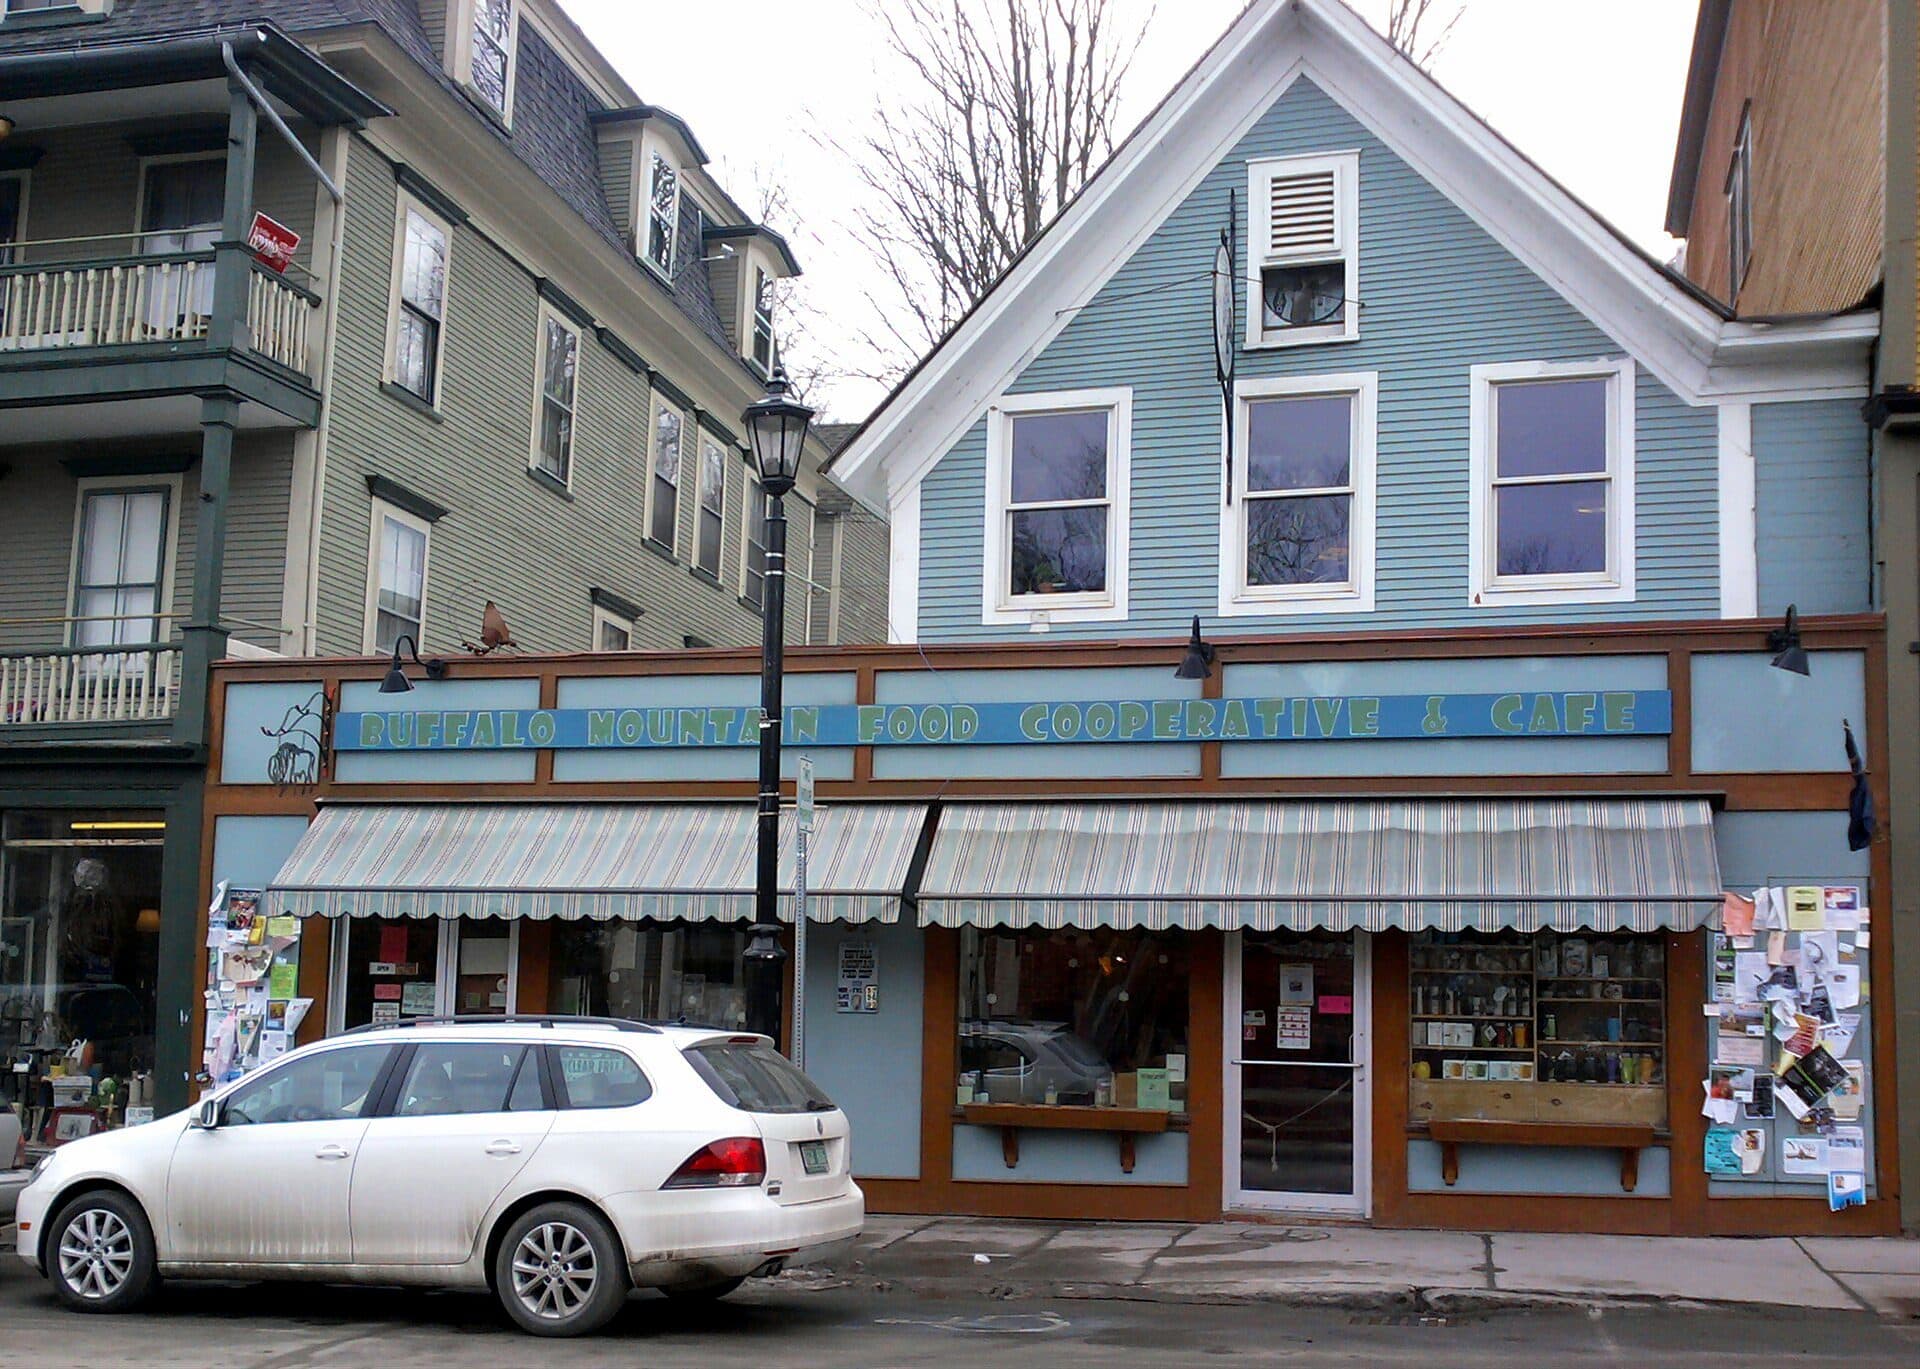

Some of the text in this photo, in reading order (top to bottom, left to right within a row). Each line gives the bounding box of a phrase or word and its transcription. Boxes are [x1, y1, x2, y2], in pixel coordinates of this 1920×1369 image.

[359, 692, 1636, 747] BUFFALO MOUNTAN FOOD COOPERATIVE & CAFE
